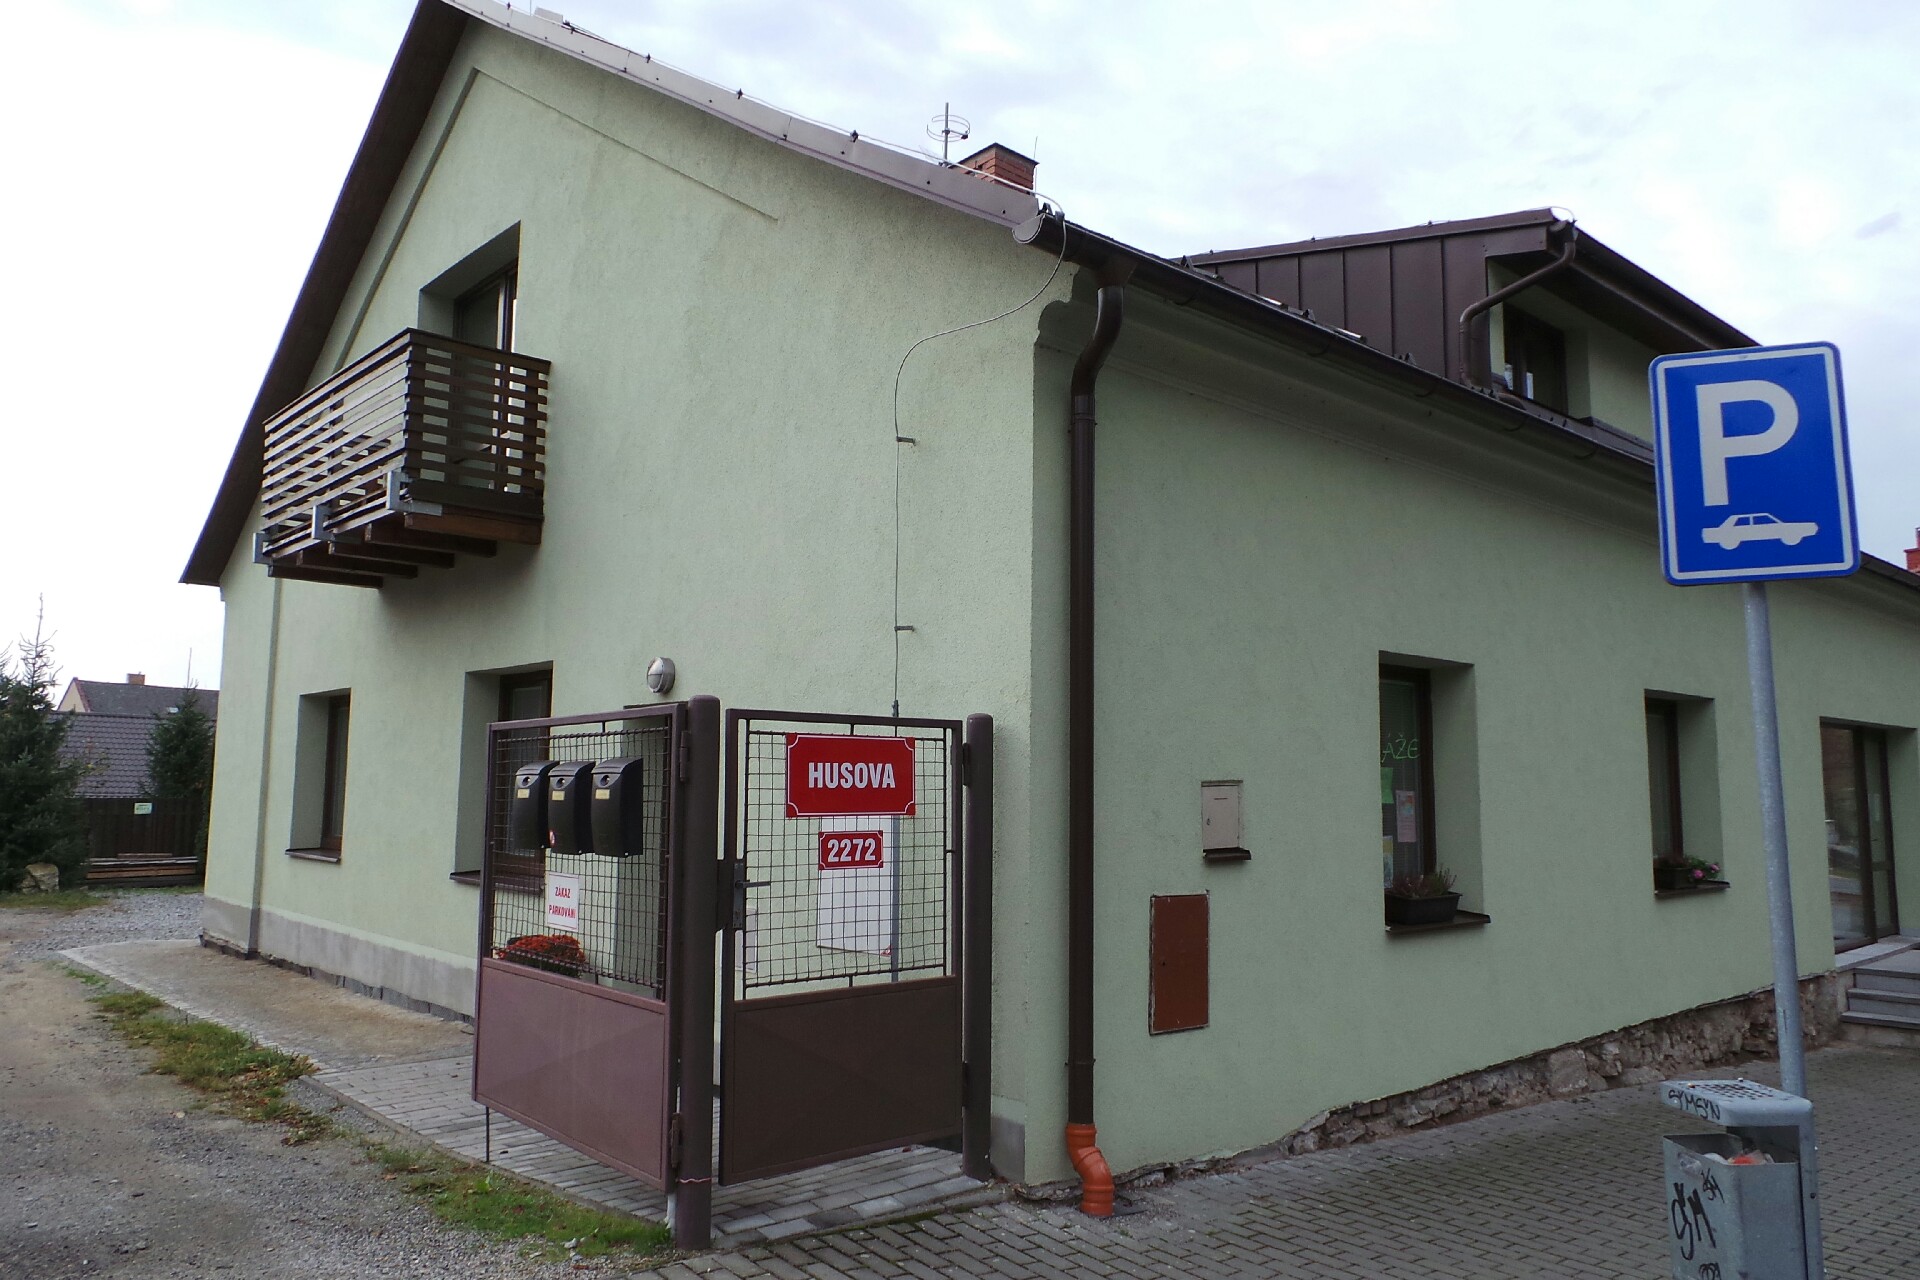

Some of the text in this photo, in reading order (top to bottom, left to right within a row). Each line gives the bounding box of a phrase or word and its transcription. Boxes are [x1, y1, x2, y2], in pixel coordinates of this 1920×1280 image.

[1696, 380, 1799, 506] P
[808, 762, 896, 789] HUSOVA
[827, 838, 876, 862] 2272
